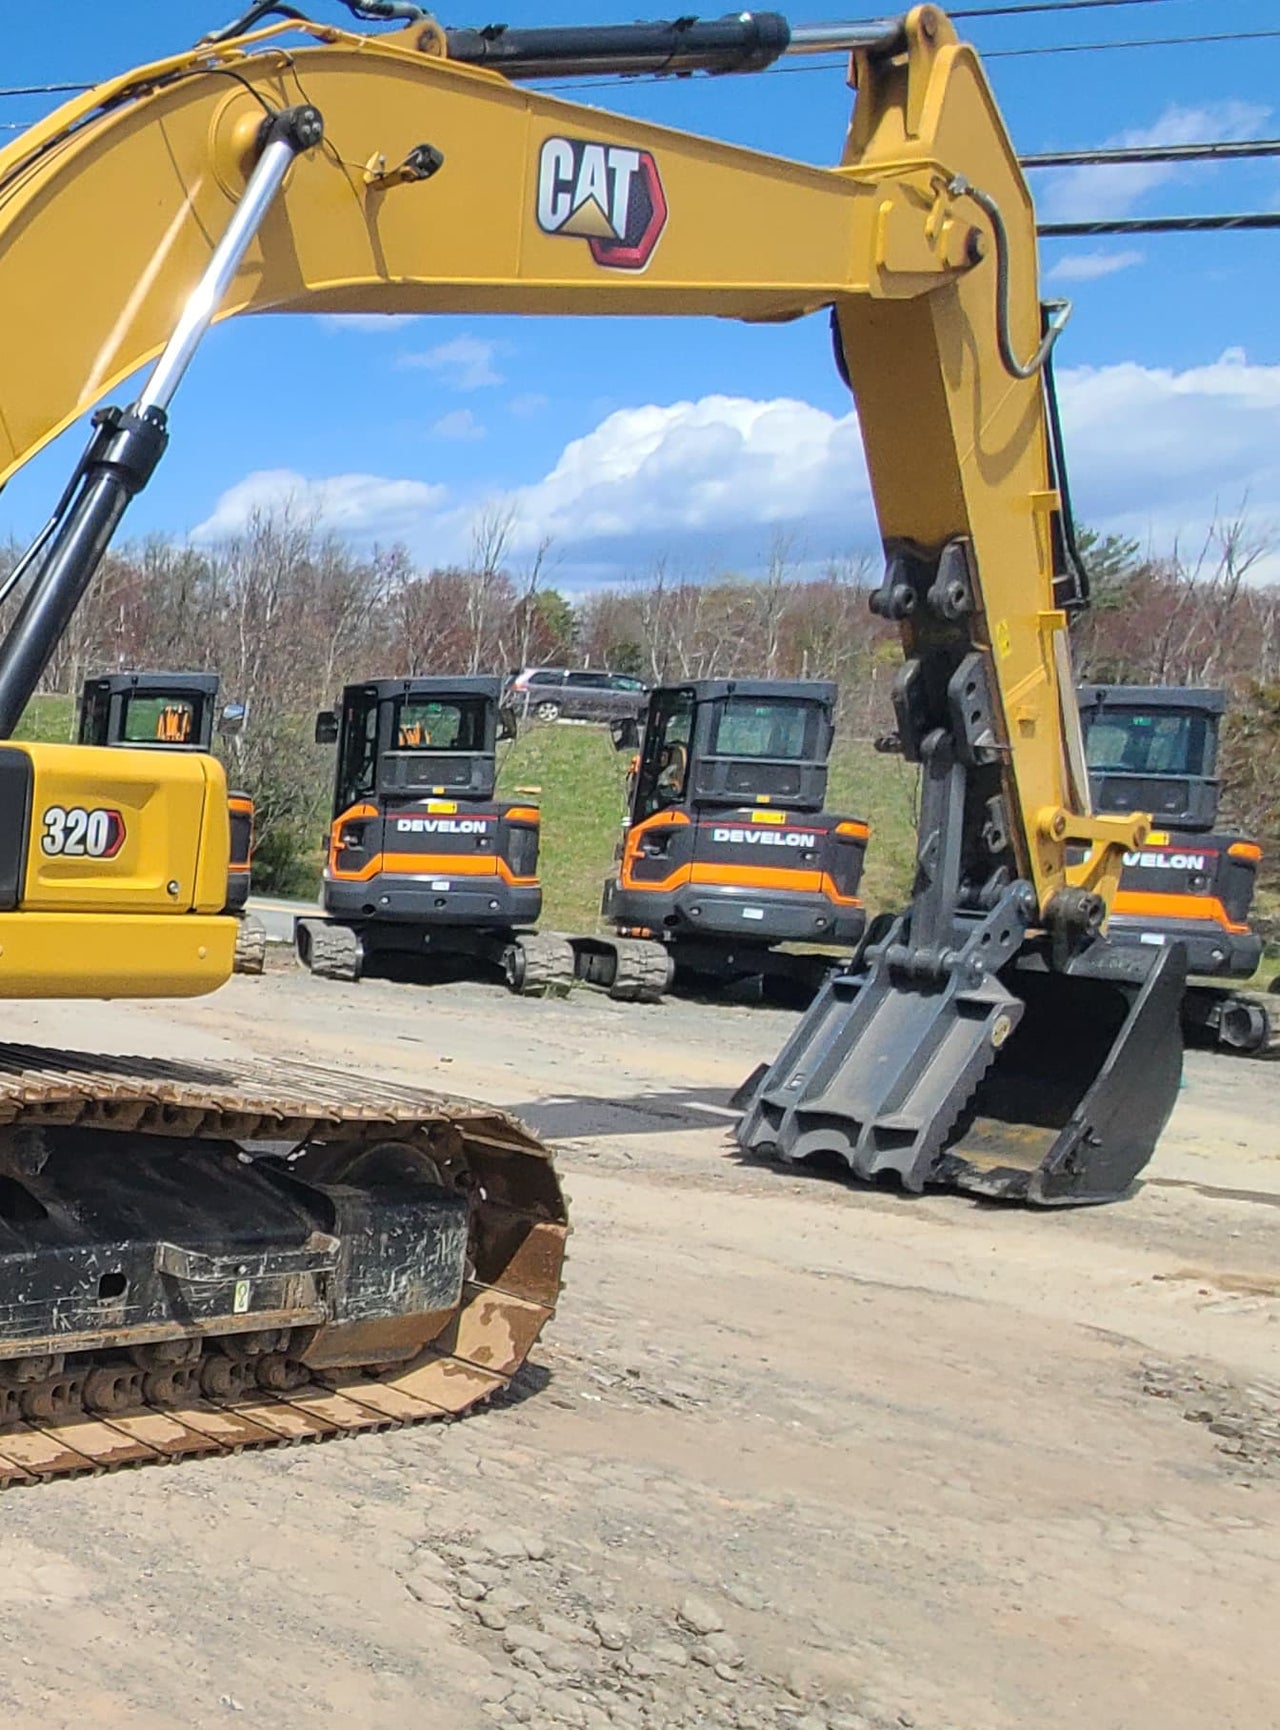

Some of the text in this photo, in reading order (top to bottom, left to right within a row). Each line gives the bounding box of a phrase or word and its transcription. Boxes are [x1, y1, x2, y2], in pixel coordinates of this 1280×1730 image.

[538, 138, 640, 240] CAT
[42, 807, 109, 857] 320
[397, 819, 487, 834] DEVELON
[713, 828, 815, 848] DEVELON
[1083, 850, 1204, 870] VELON
